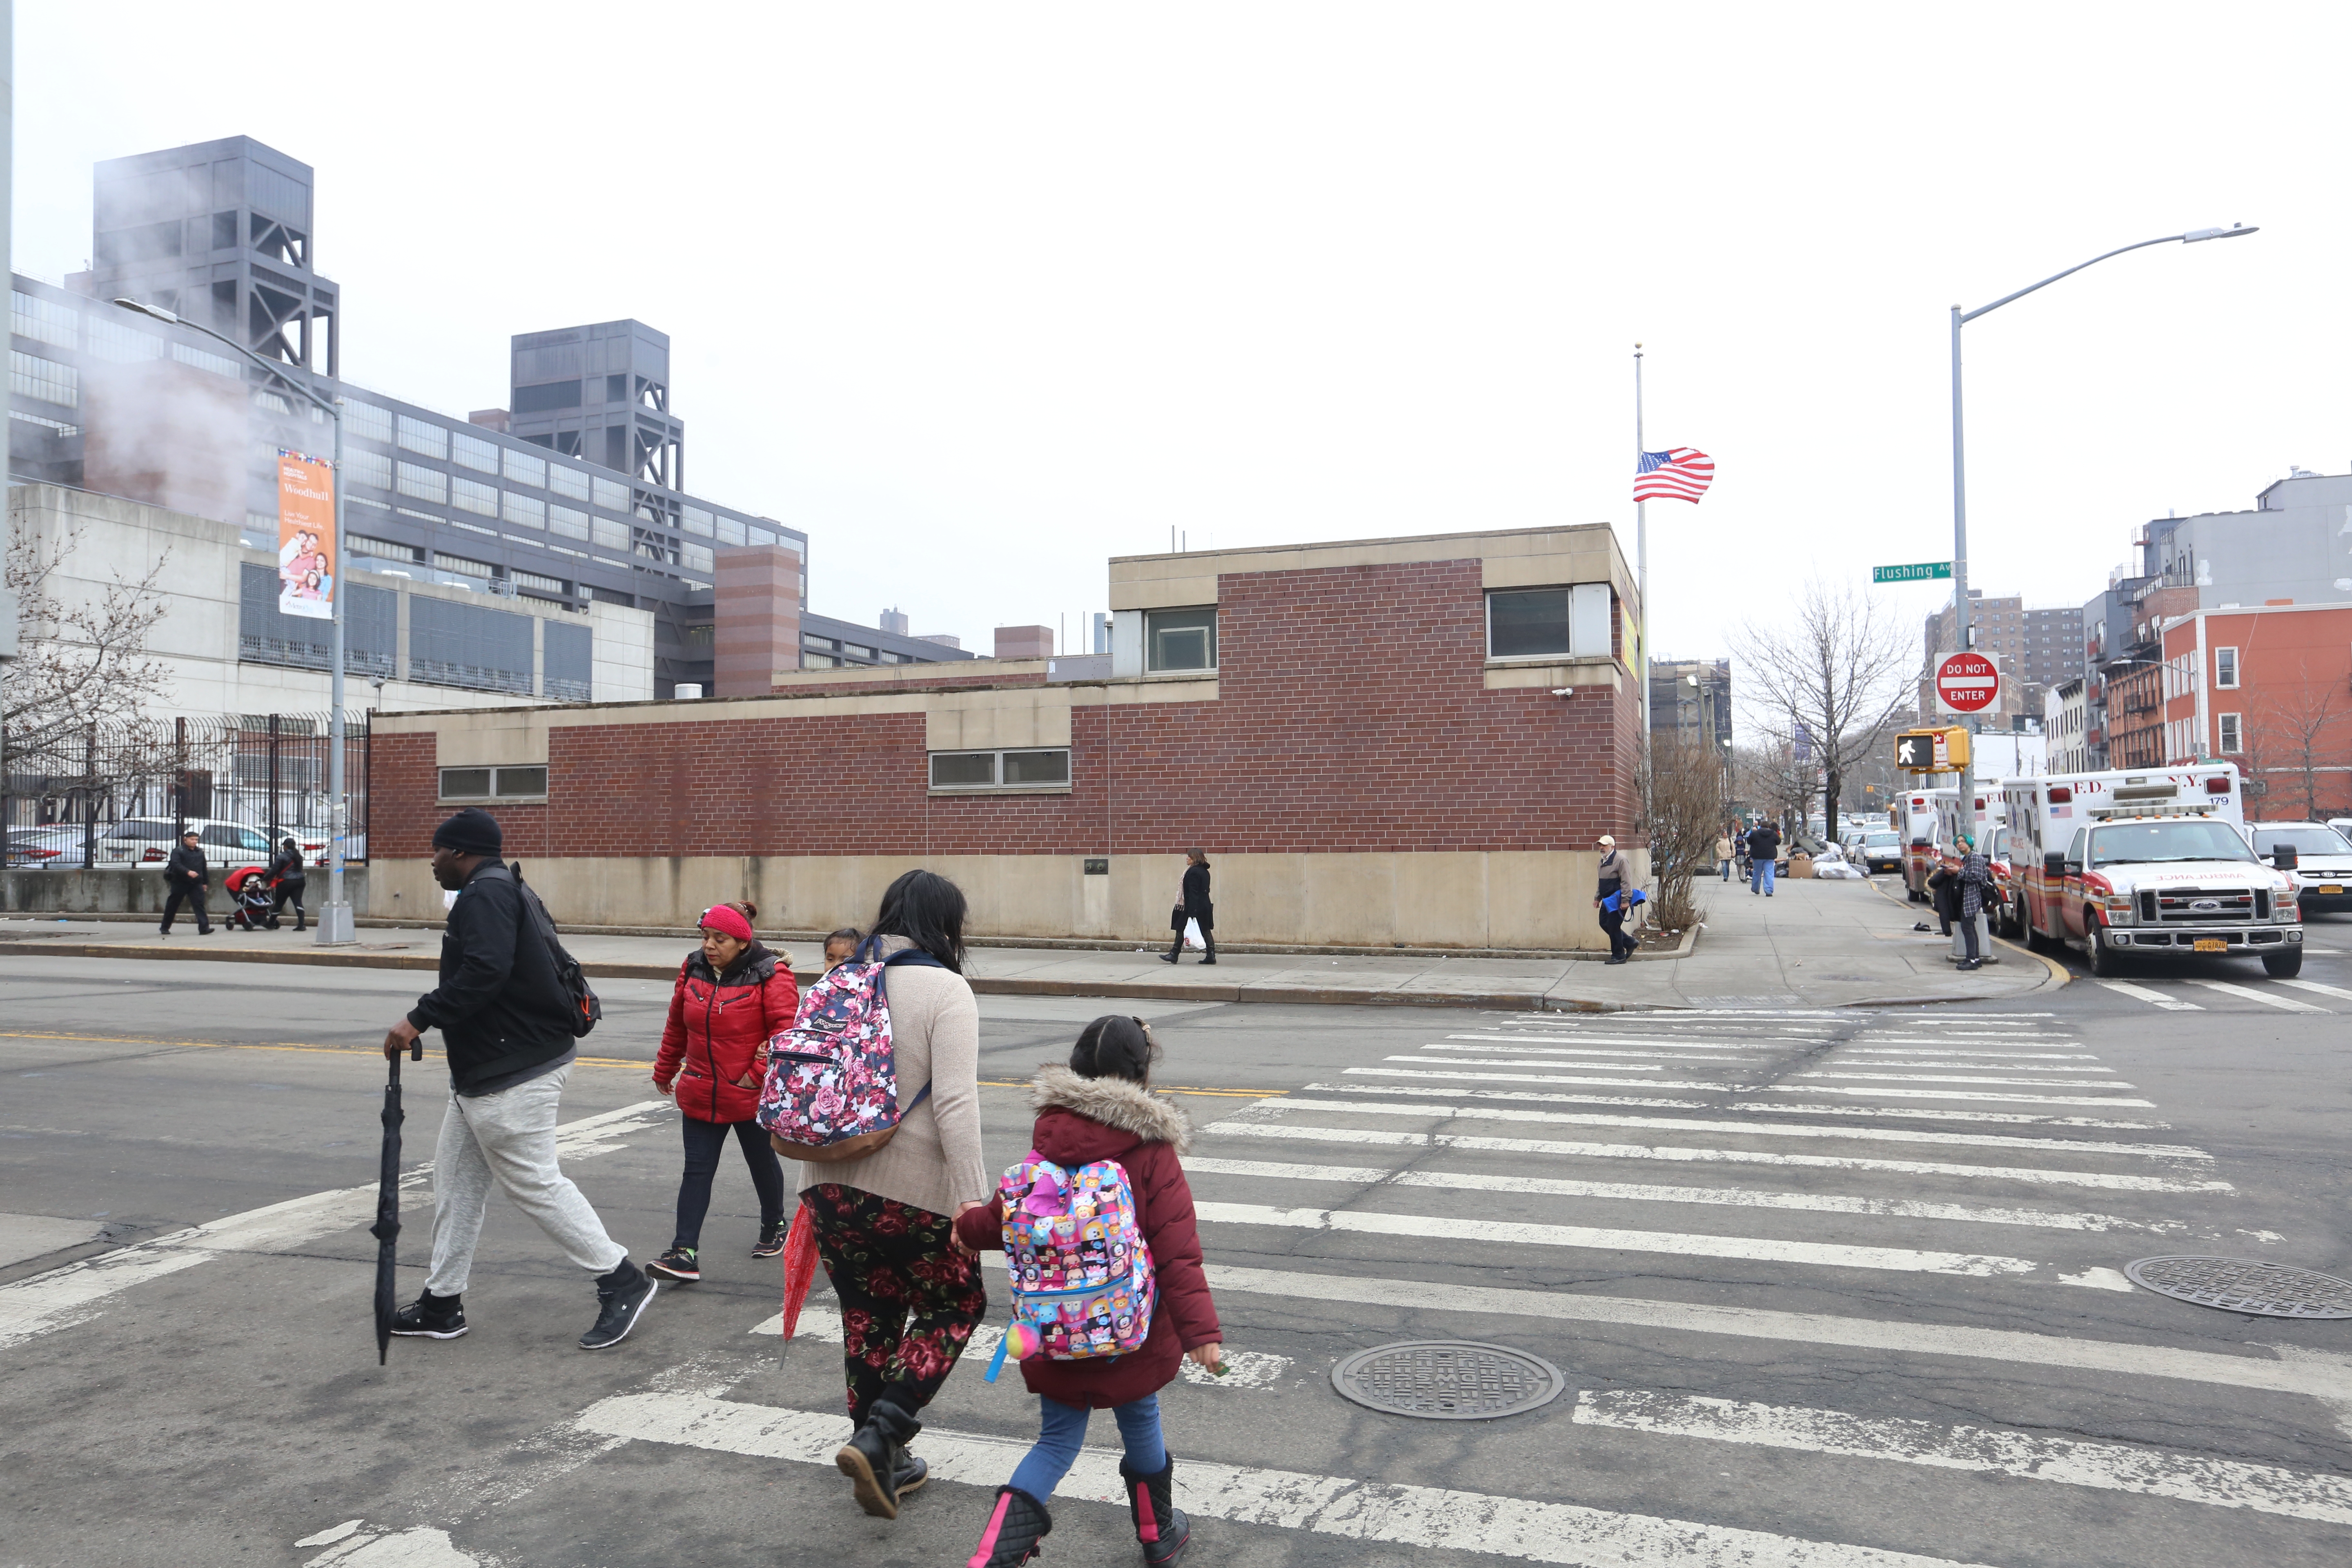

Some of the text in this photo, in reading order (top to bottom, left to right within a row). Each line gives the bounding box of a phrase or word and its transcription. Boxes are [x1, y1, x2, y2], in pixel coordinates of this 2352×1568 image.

[283, 471, 307, 480] HOSPITALS
[284, 483, 328, 501] Woodhull
[296, 512, 309, 520] Your
[285, 517, 312, 527] Healthiest
[1874, 565, 1933, 579] Flushing
[1947, 664, 1987, 674] DO NOT
[1951, 690, 1985, 700] ENTER
[2074, 781, 2107, 794] F.D.
[2209, 797, 2229, 805] 179
